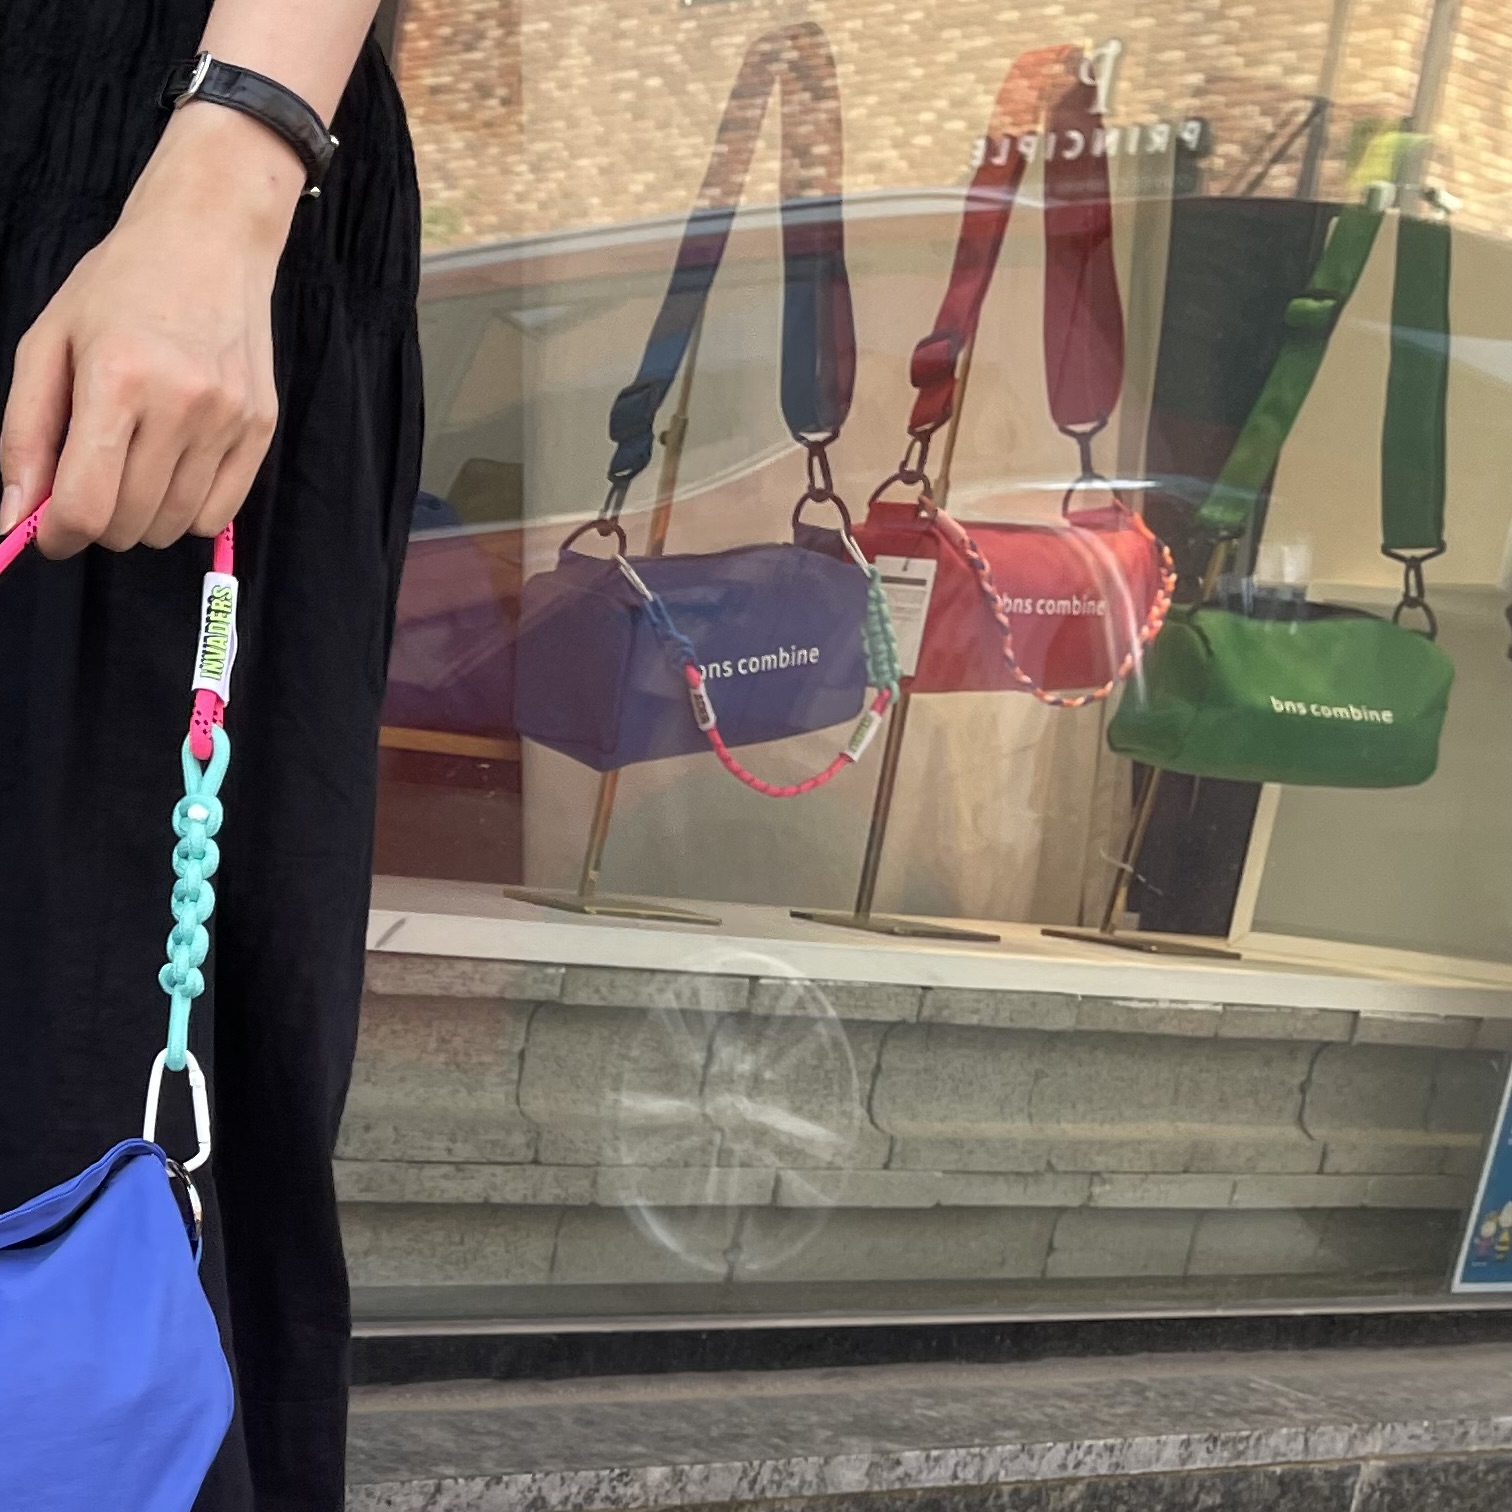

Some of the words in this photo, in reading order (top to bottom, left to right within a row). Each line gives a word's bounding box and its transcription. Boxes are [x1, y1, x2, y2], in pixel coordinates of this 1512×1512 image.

[1035, 594, 1107, 617] combine
[199, 584, 233, 681] INVADERS
[737, 644, 820, 675] combine
[1270, 695, 1307, 716] bns
[1310, 703, 1394, 725] combine
